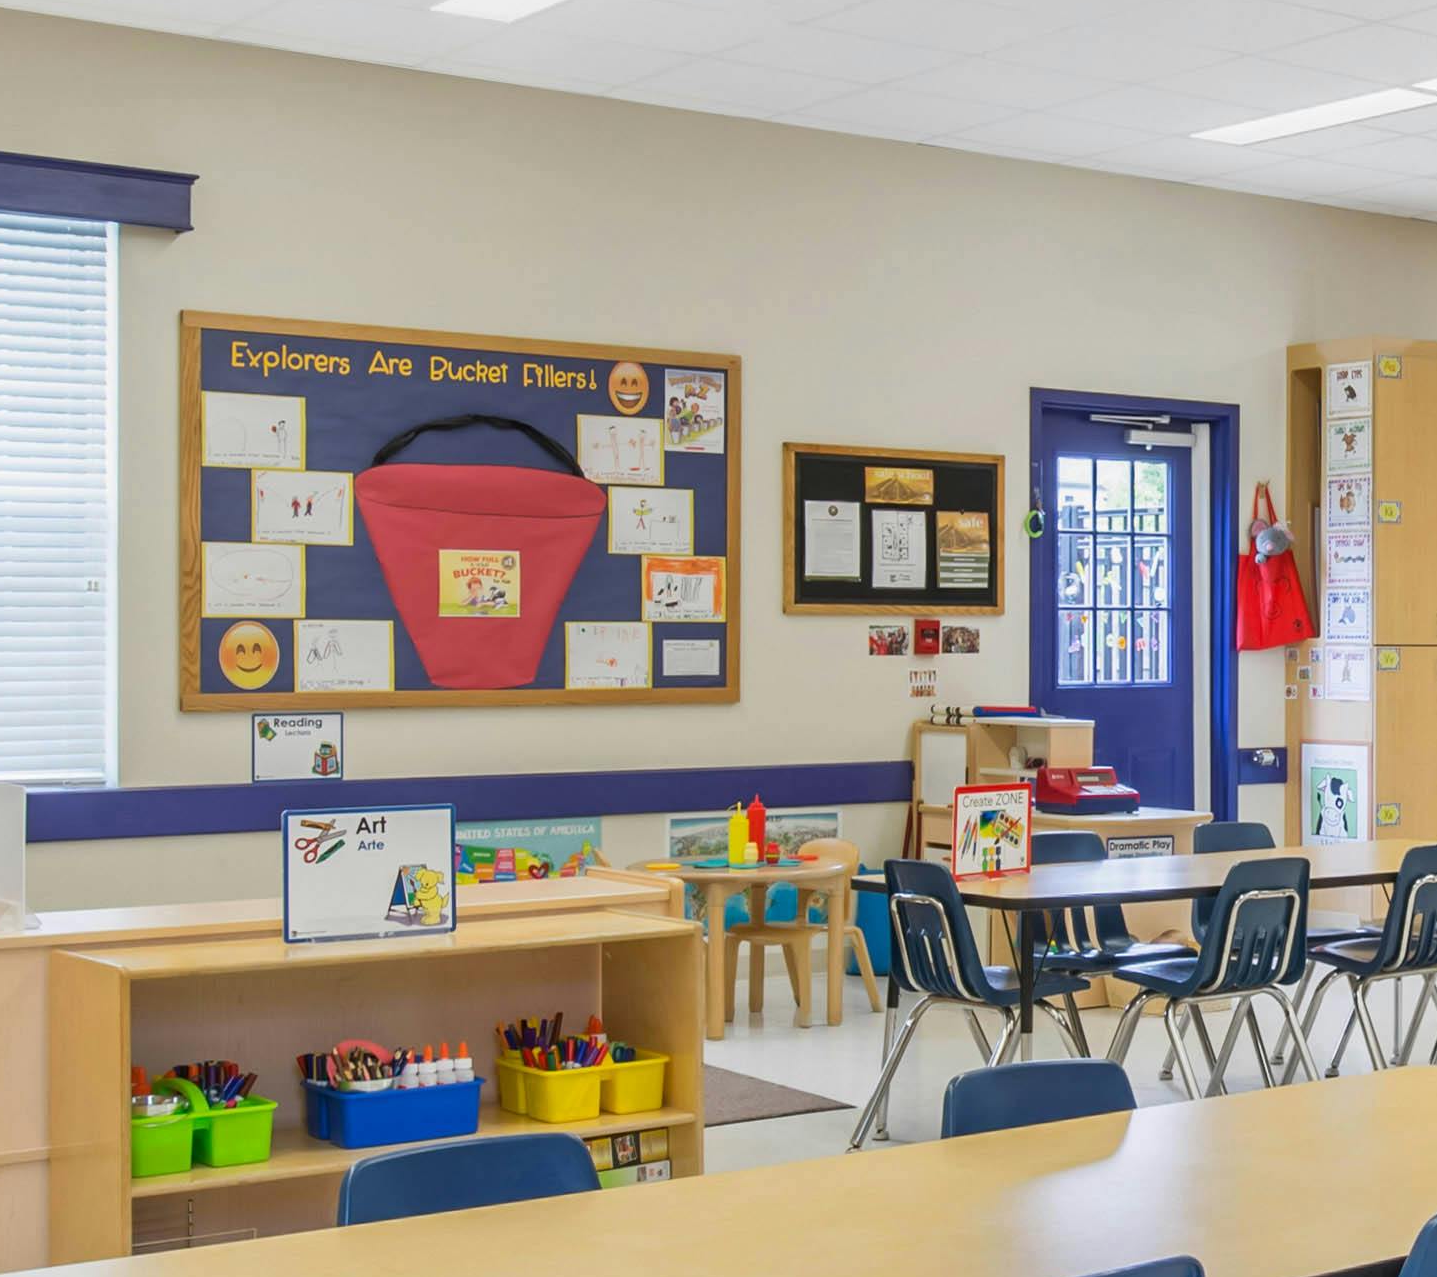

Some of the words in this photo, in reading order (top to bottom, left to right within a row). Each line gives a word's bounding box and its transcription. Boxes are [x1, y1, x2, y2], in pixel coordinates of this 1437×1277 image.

[231, 341, 352, 378] Explorers
[368, 350, 413, 377] Are
[430, 356, 509, 385] Bucket
[523, 363, 598, 391] Fillers!
[452, 567, 507, 579] BUCKET?
[273, 716, 323, 730] Reading
[962, 794, 994, 807] Create
[995, 792, 1024, 806] ZONE
[355, 815, 387, 835] Art
[494, 826, 532, 838] STATES
[533, 825, 547, 837] OF
[358, 839, 385, 852] Arte
[1109, 841, 1151, 851] Dramatic
[1152, 840, 1171, 852] Play
